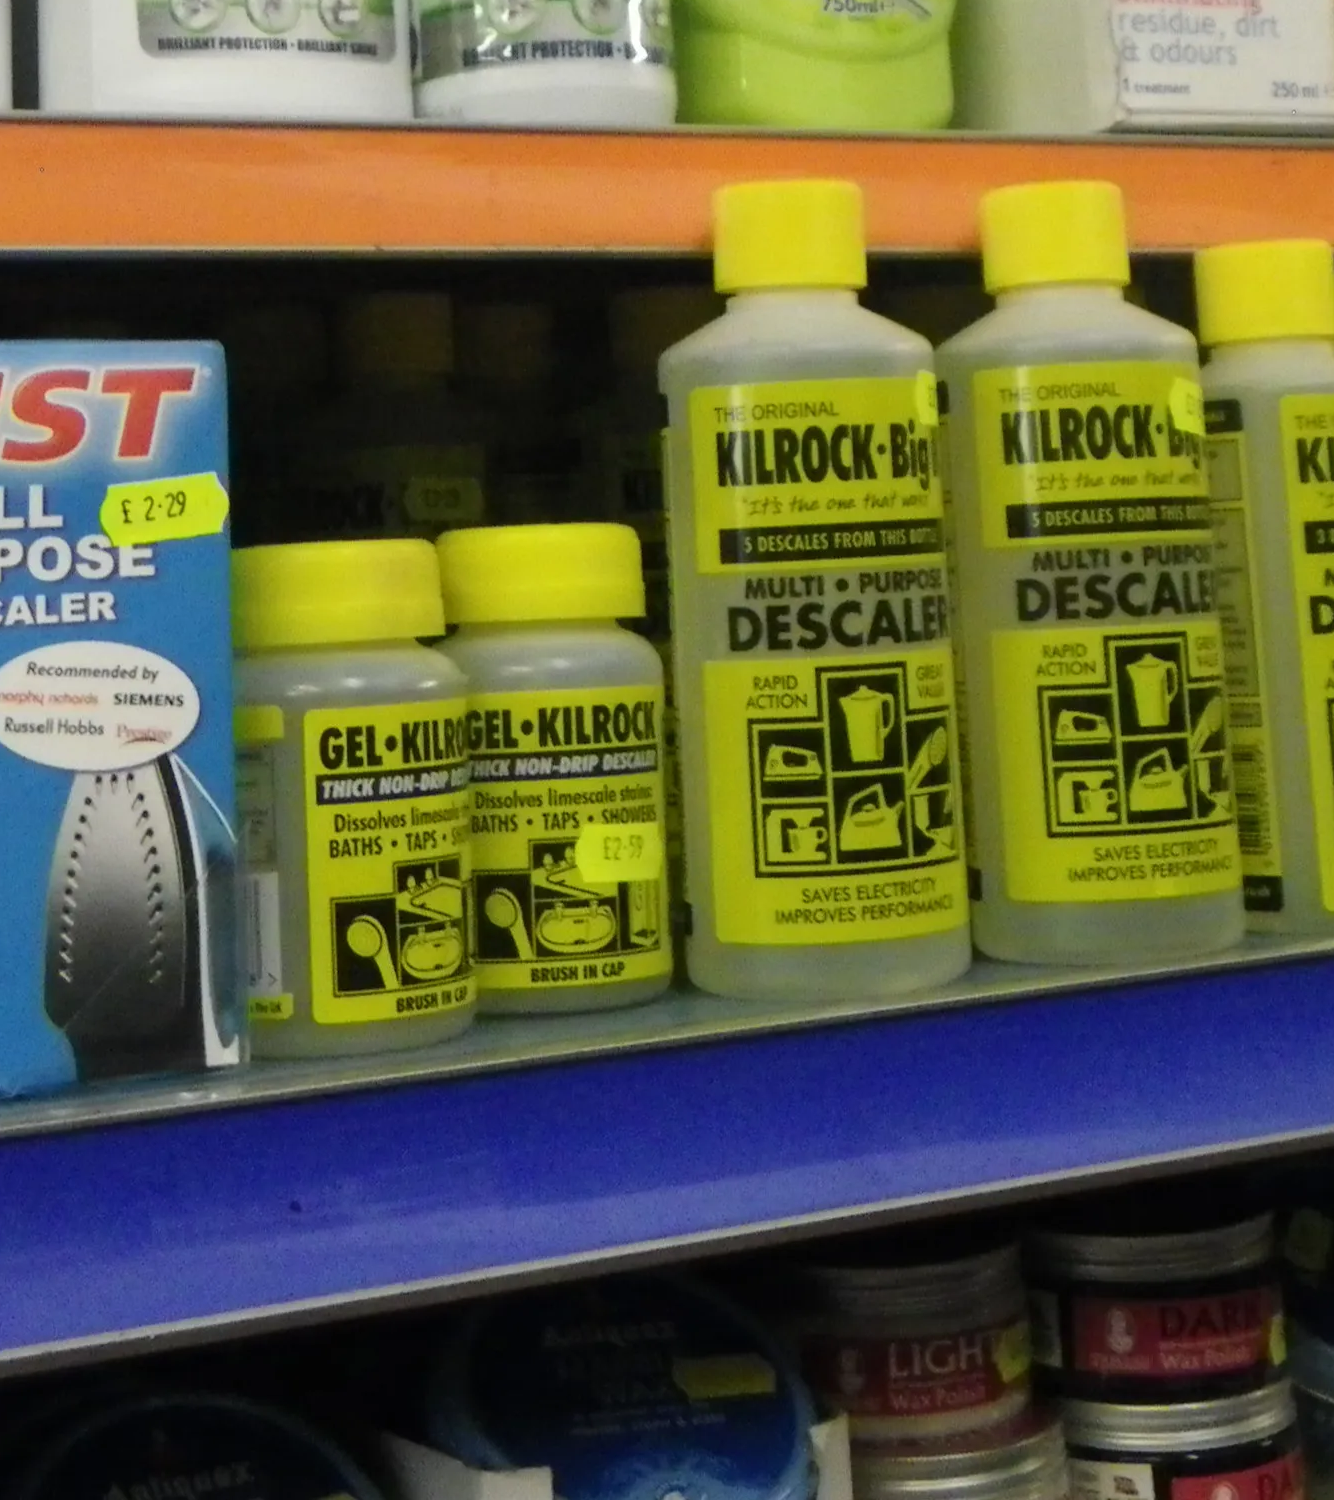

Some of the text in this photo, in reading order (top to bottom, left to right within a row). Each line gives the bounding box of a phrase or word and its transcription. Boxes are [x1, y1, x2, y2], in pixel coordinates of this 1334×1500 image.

[1235, 15, 1281, 39] dirt
[1150, 38, 1238, 65] odours
[714, 401, 839, 423] THE ORIGINAL
[758, 531, 876, 552] DESCALES FROM
[745, 575, 824, 600] MULTI
[27, 661, 159, 683] Recommended by
[752, 673, 799, 692] RAPID
[113, 692, 185, 707] SIEMENS
[745, 693, 809, 711] ACTION
[5, 717, 104, 735] Russell Hobbs
[537, 701, 656, 748] KILROCK
[515, 753, 599, 777] NON-DRIP
[322, 778, 375, 799] THICK
[474, 785, 618, 810] Dissolves limescale
[334, 810, 406, 833] Dissolves
[542, 805, 657, 831] TAPS SHOWERS
[329, 830, 437, 858] BATHS TAPS
[802, 883, 852, 905] SAVES
[774, 904, 857, 926] IMPROVES
[530, 961, 625, 984] BRUSH IN CAP
[889, 1334, 993, 1378] LIGH
